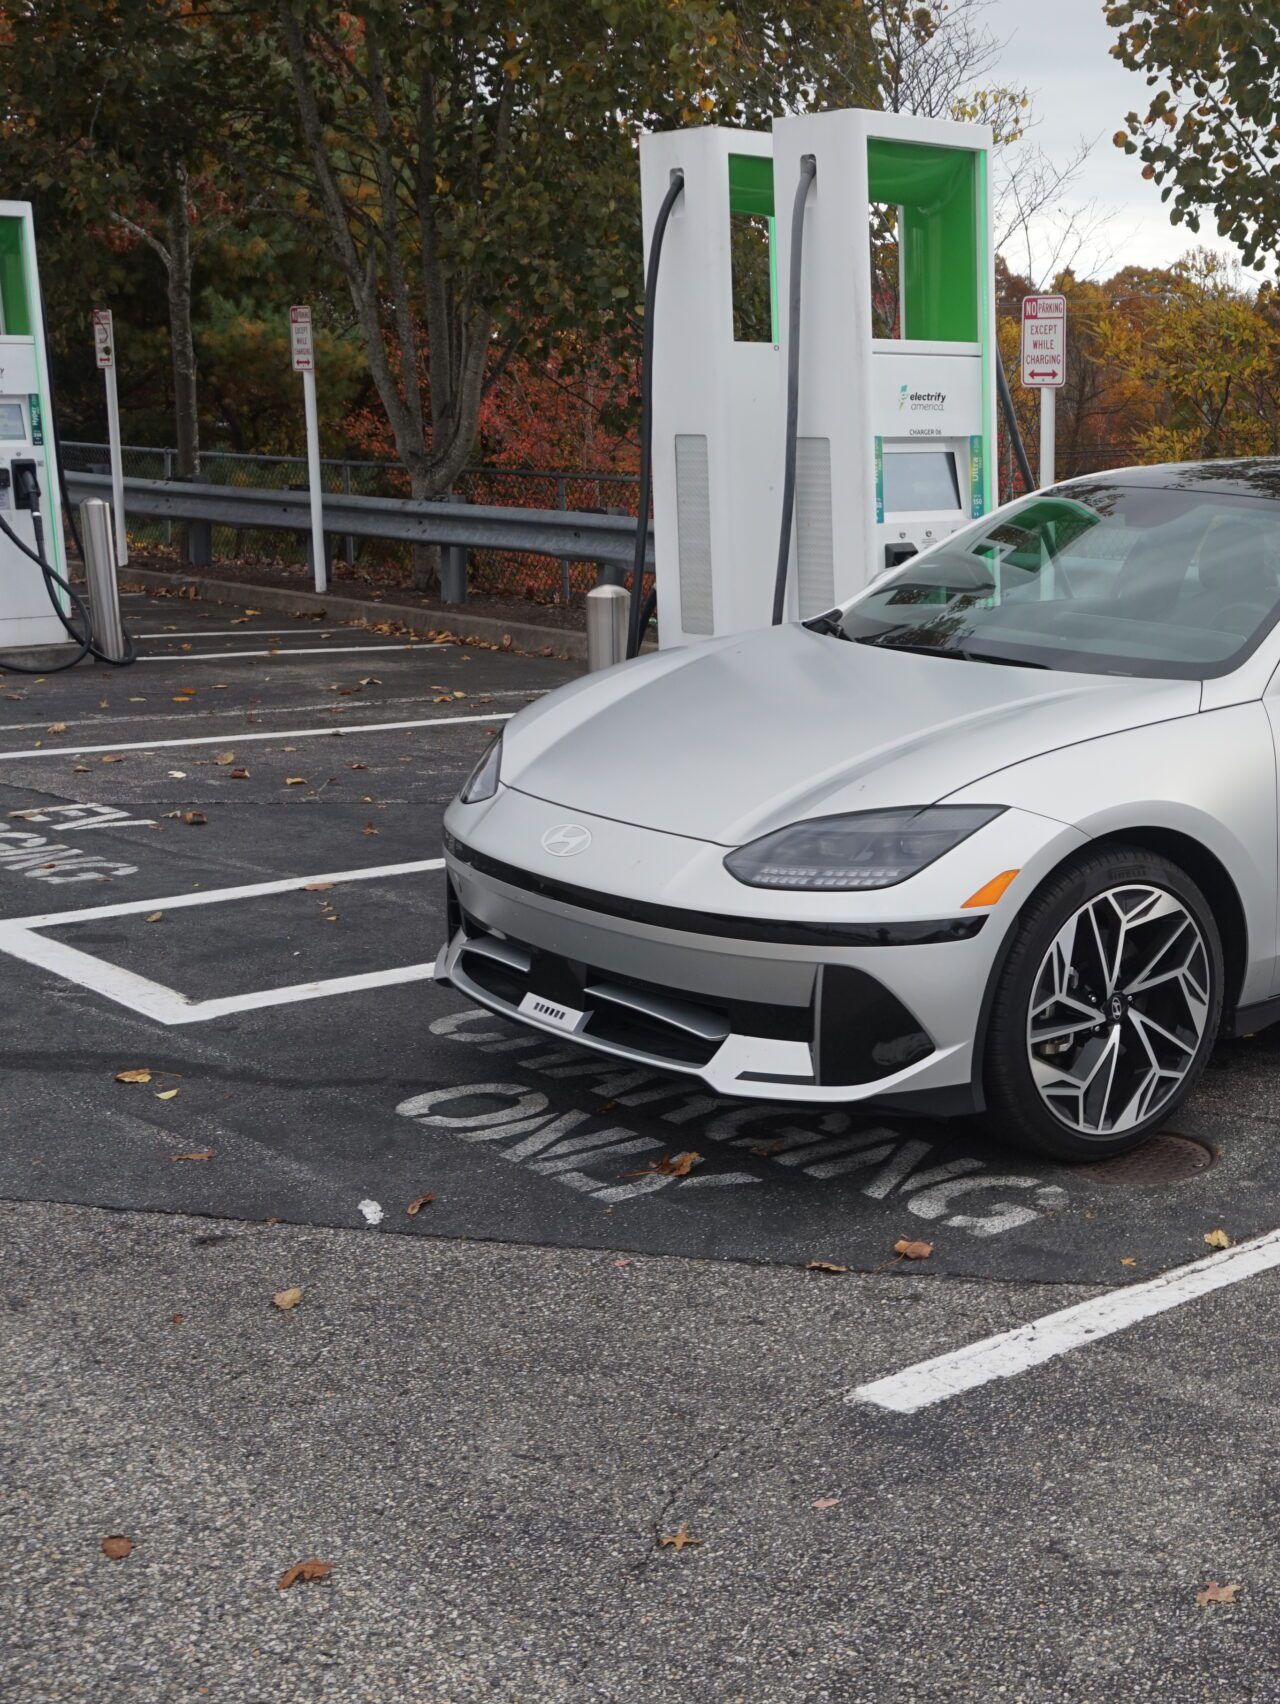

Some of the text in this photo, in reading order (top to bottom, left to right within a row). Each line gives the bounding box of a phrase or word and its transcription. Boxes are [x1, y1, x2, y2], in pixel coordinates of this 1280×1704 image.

[1026, 302, 1062, 315] NO PARKING
[1031, 325, 1056, 335] EXCEPT
[1033, 340, 1054, 349] WHILE
[1026, 354, 1060, 364] CHARGING
[909, 392, 946, 403] electrify
[910, 403, 945, 411] america
[394, 1082, 764, 1203] ONLY
